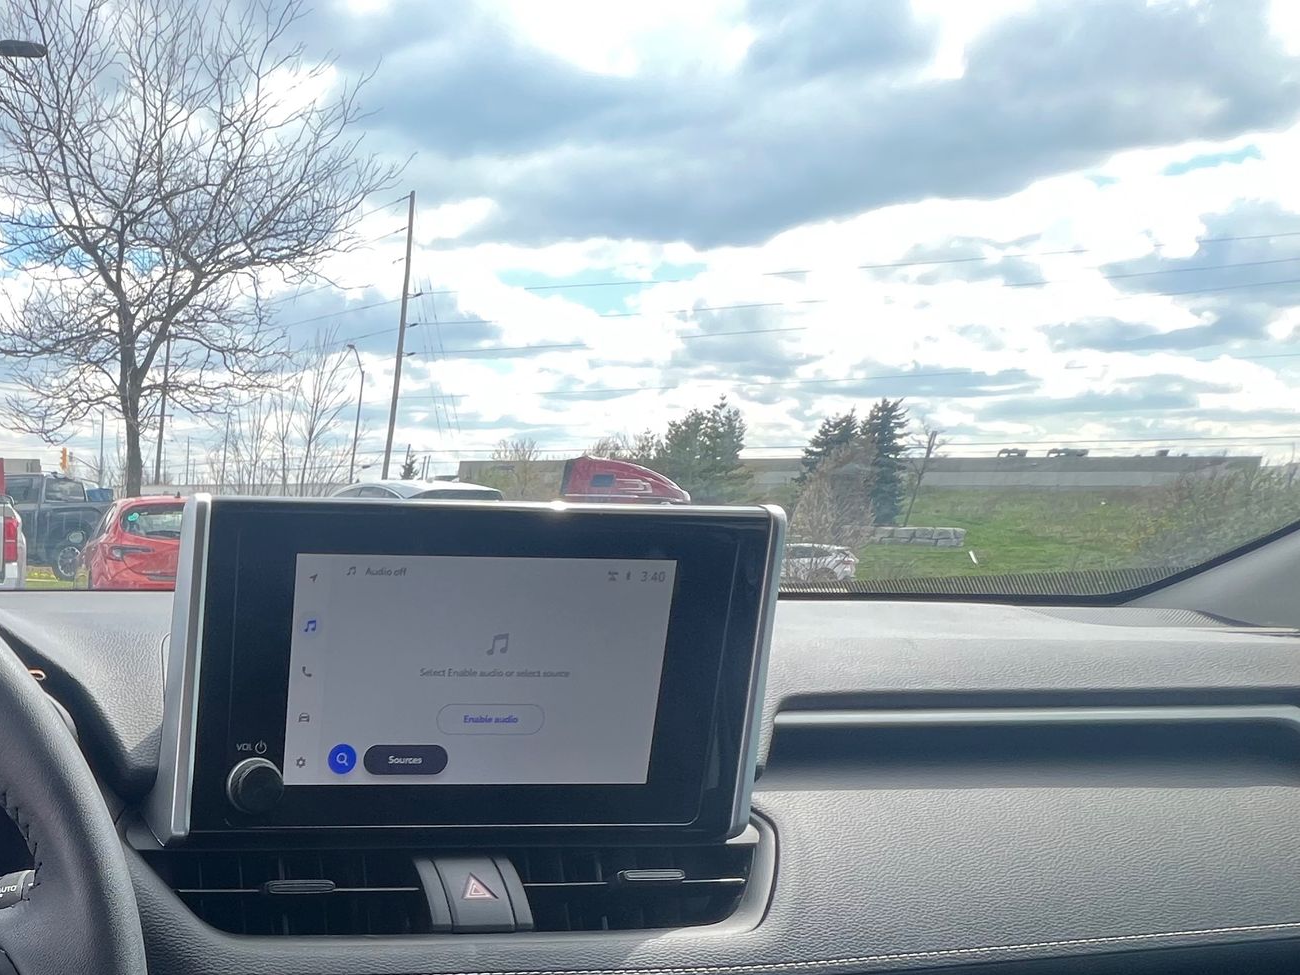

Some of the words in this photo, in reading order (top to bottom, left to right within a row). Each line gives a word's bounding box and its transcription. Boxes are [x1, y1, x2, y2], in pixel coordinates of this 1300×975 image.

[365, 567, 393, 577] Audio
[393, 567, 407, 577] off
[640, 571, 666, 582] 3:40
[419, 668, 446, 678] Select
[447, 668, 478, 678] Enable
[479, 669, 503, 678] audio
[505, 670, 515, 678] or
[516, 669, 541, 678] select
[463, 715, 493, 724] Enable
[494, 715, 518, 724] audio
[236, 743, 253, 751] VOL
[388, 755, 423, 765] Sources
